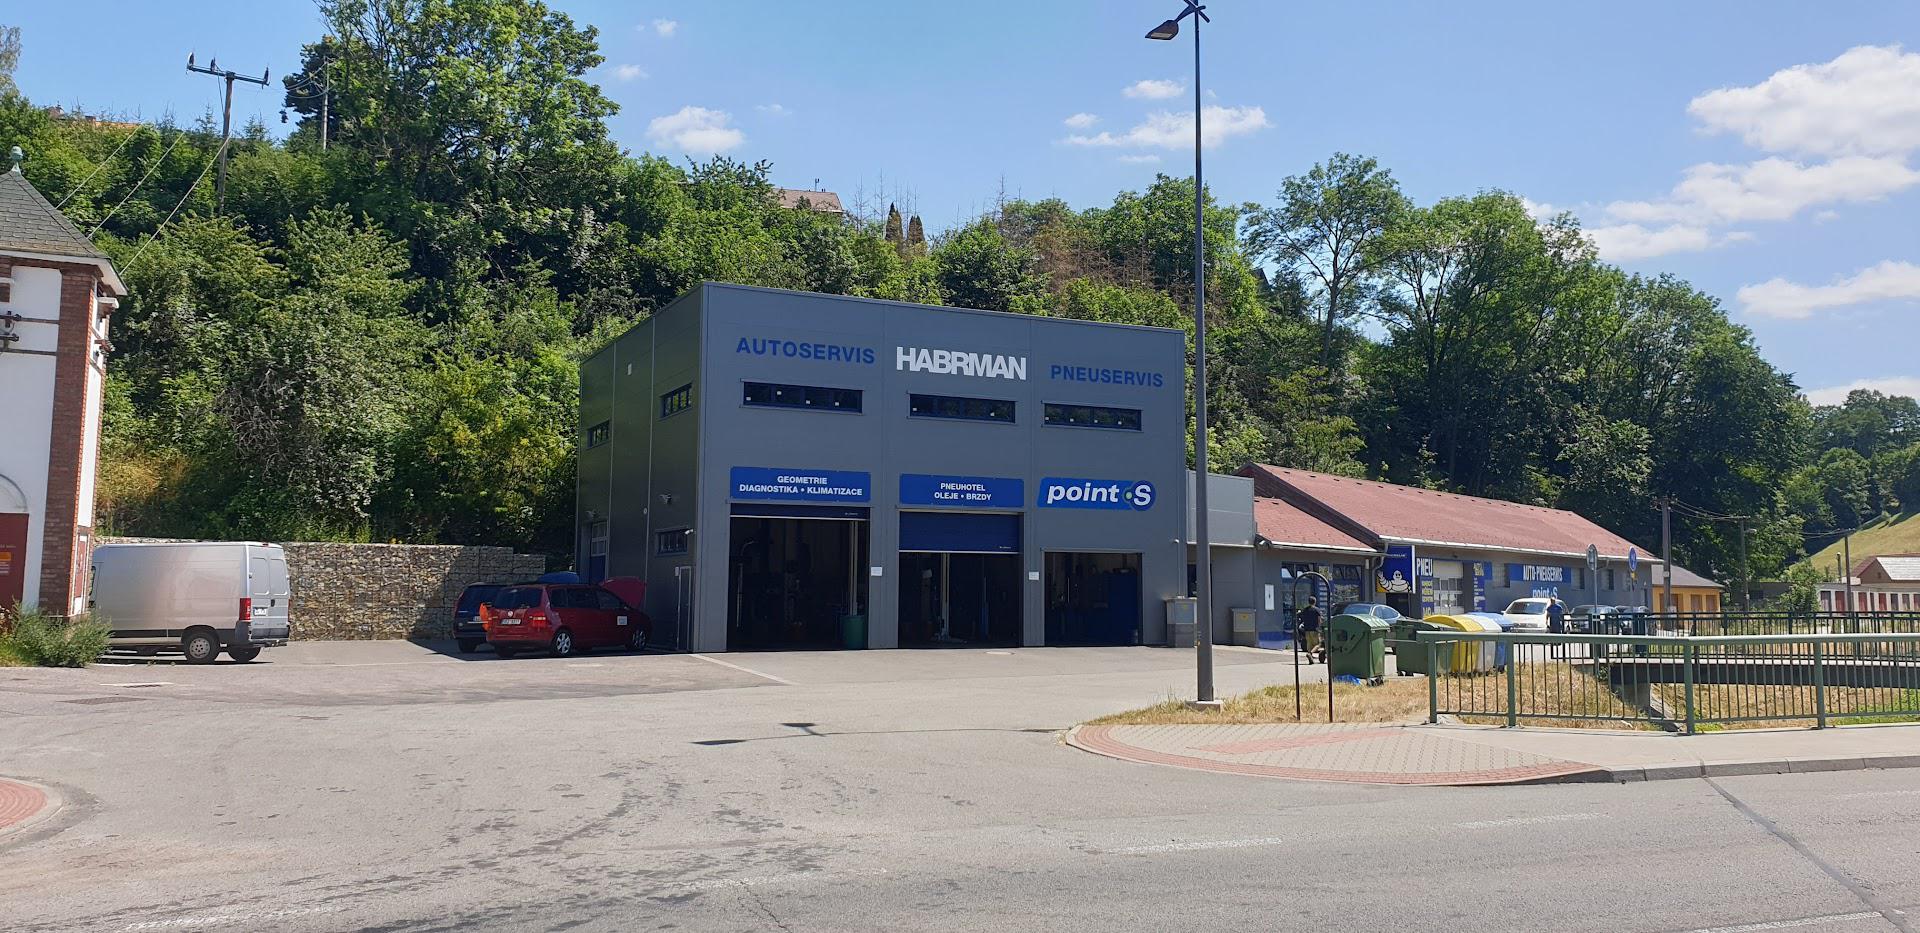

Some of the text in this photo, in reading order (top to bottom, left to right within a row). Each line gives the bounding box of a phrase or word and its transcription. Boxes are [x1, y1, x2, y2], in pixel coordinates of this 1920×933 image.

[736, 337, 875, 364] AUTOSERVIS
[896, 346, 1027, 381] HABRMAN
[1051, 364, 1163, 388] PNEUSERVIS
[777, 475, 828, 485] GEOMETRIE
[940, 482, 986, 492] PNEUHOTEL
[739, 484, 863, 496] DIAGNOSTIKA KLIMATIZACE
[934, 492, 992, 501] OLEJE BRZDY
[1047, 482, 1119, 504] point
[1416, 558, 1433, 577] PNEU
